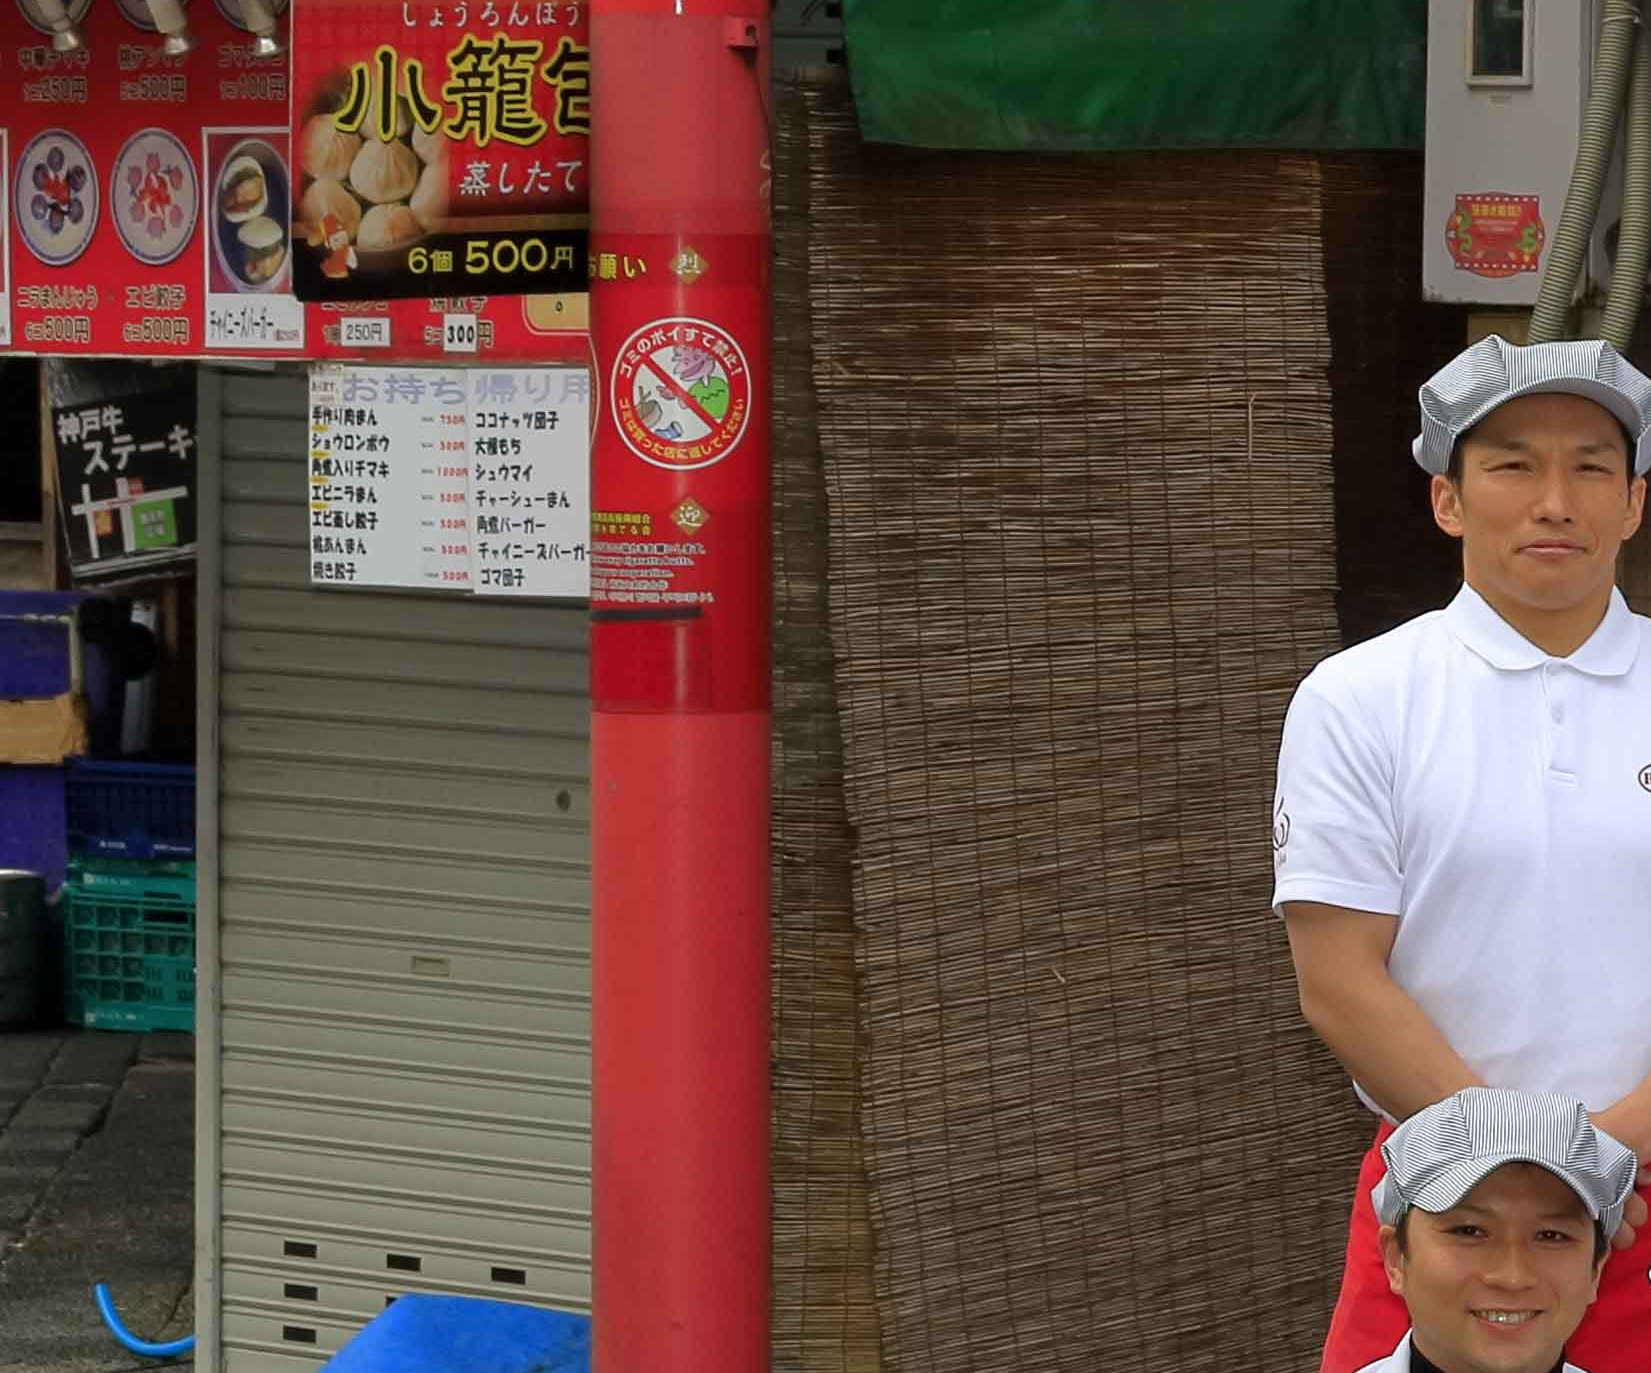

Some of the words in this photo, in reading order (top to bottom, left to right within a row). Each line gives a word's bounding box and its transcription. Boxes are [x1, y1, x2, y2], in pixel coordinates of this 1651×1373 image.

[402, 0, 582, 28] しょうろんぼう
[407, 245, 453, 274] 6個
[465, 238, 574, 275] 500円
